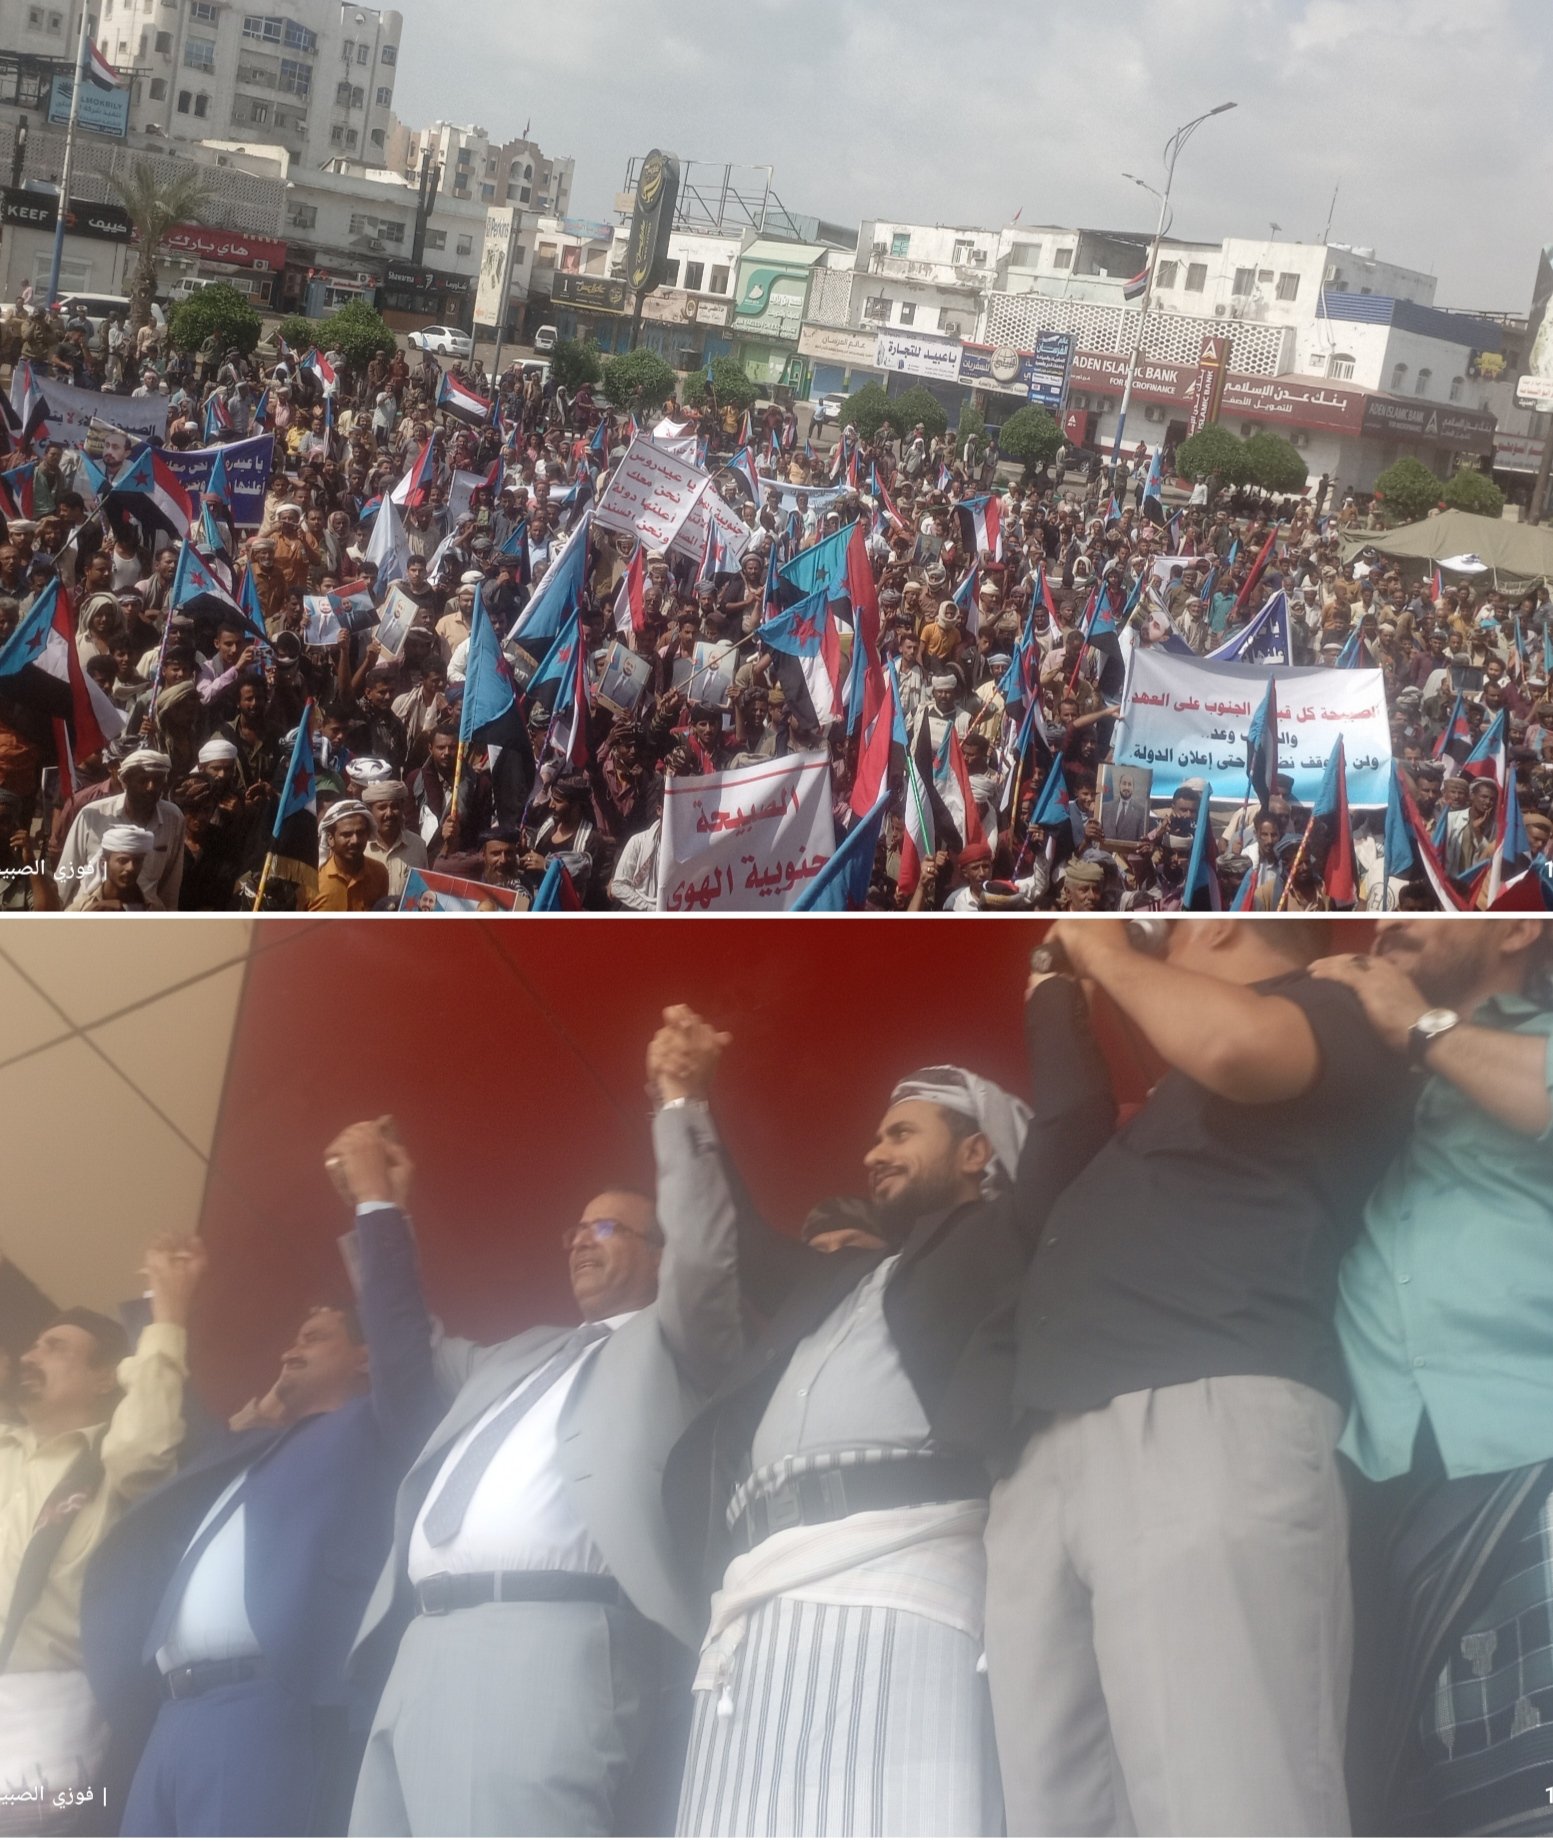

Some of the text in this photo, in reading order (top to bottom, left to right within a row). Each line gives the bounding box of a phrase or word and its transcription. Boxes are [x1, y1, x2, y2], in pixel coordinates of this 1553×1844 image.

[7, 205, 49, 221] KEEF
[88, 218, 127, 233] كييف
[168, 234, 249, 256] هاي بارك
[888, 341, 922, 357] للتجارة
[1072, 355, 1101, 371] ADEN
[1145, 366, 1179, 383] BANK
[1109, 377, 1177, 394] FOR CROFINANCE
[1204, 370, 1214, 395] BANK
[1222, 395, 1292, 412] للتمويل الأصغ
[1223, 381, 1348, 411] بنك عدن الإسلامي
[1368, 403, 1425, 423] ADEN ISLAMIC BANK
[255, 456, 263, 473] يا
[629, 454, 682, 482] عيدروس
[234, 476, 266, 495] أعلنها
[612, 481, 637, 501] دولة
[626, 470, 681, 503] نحن معك
[687, 479, 697, 493] يا
[600, 502, 636, 520] السند
[636, 520, 670, 545] ونحن
[1173, 696, 1200, 711] على
[1204, 700, 1250, 717] الجنوب
[1296, 706, 1316, 723] كل
[1178, 750, 1213, 770] إعلان
[1217, 755, 1246, 770] حتى
[1352, 755, 1379, 770] ولن
[692, 785, 801, 836] الصبيحة
[666, 864, 733, 911] الهوى
